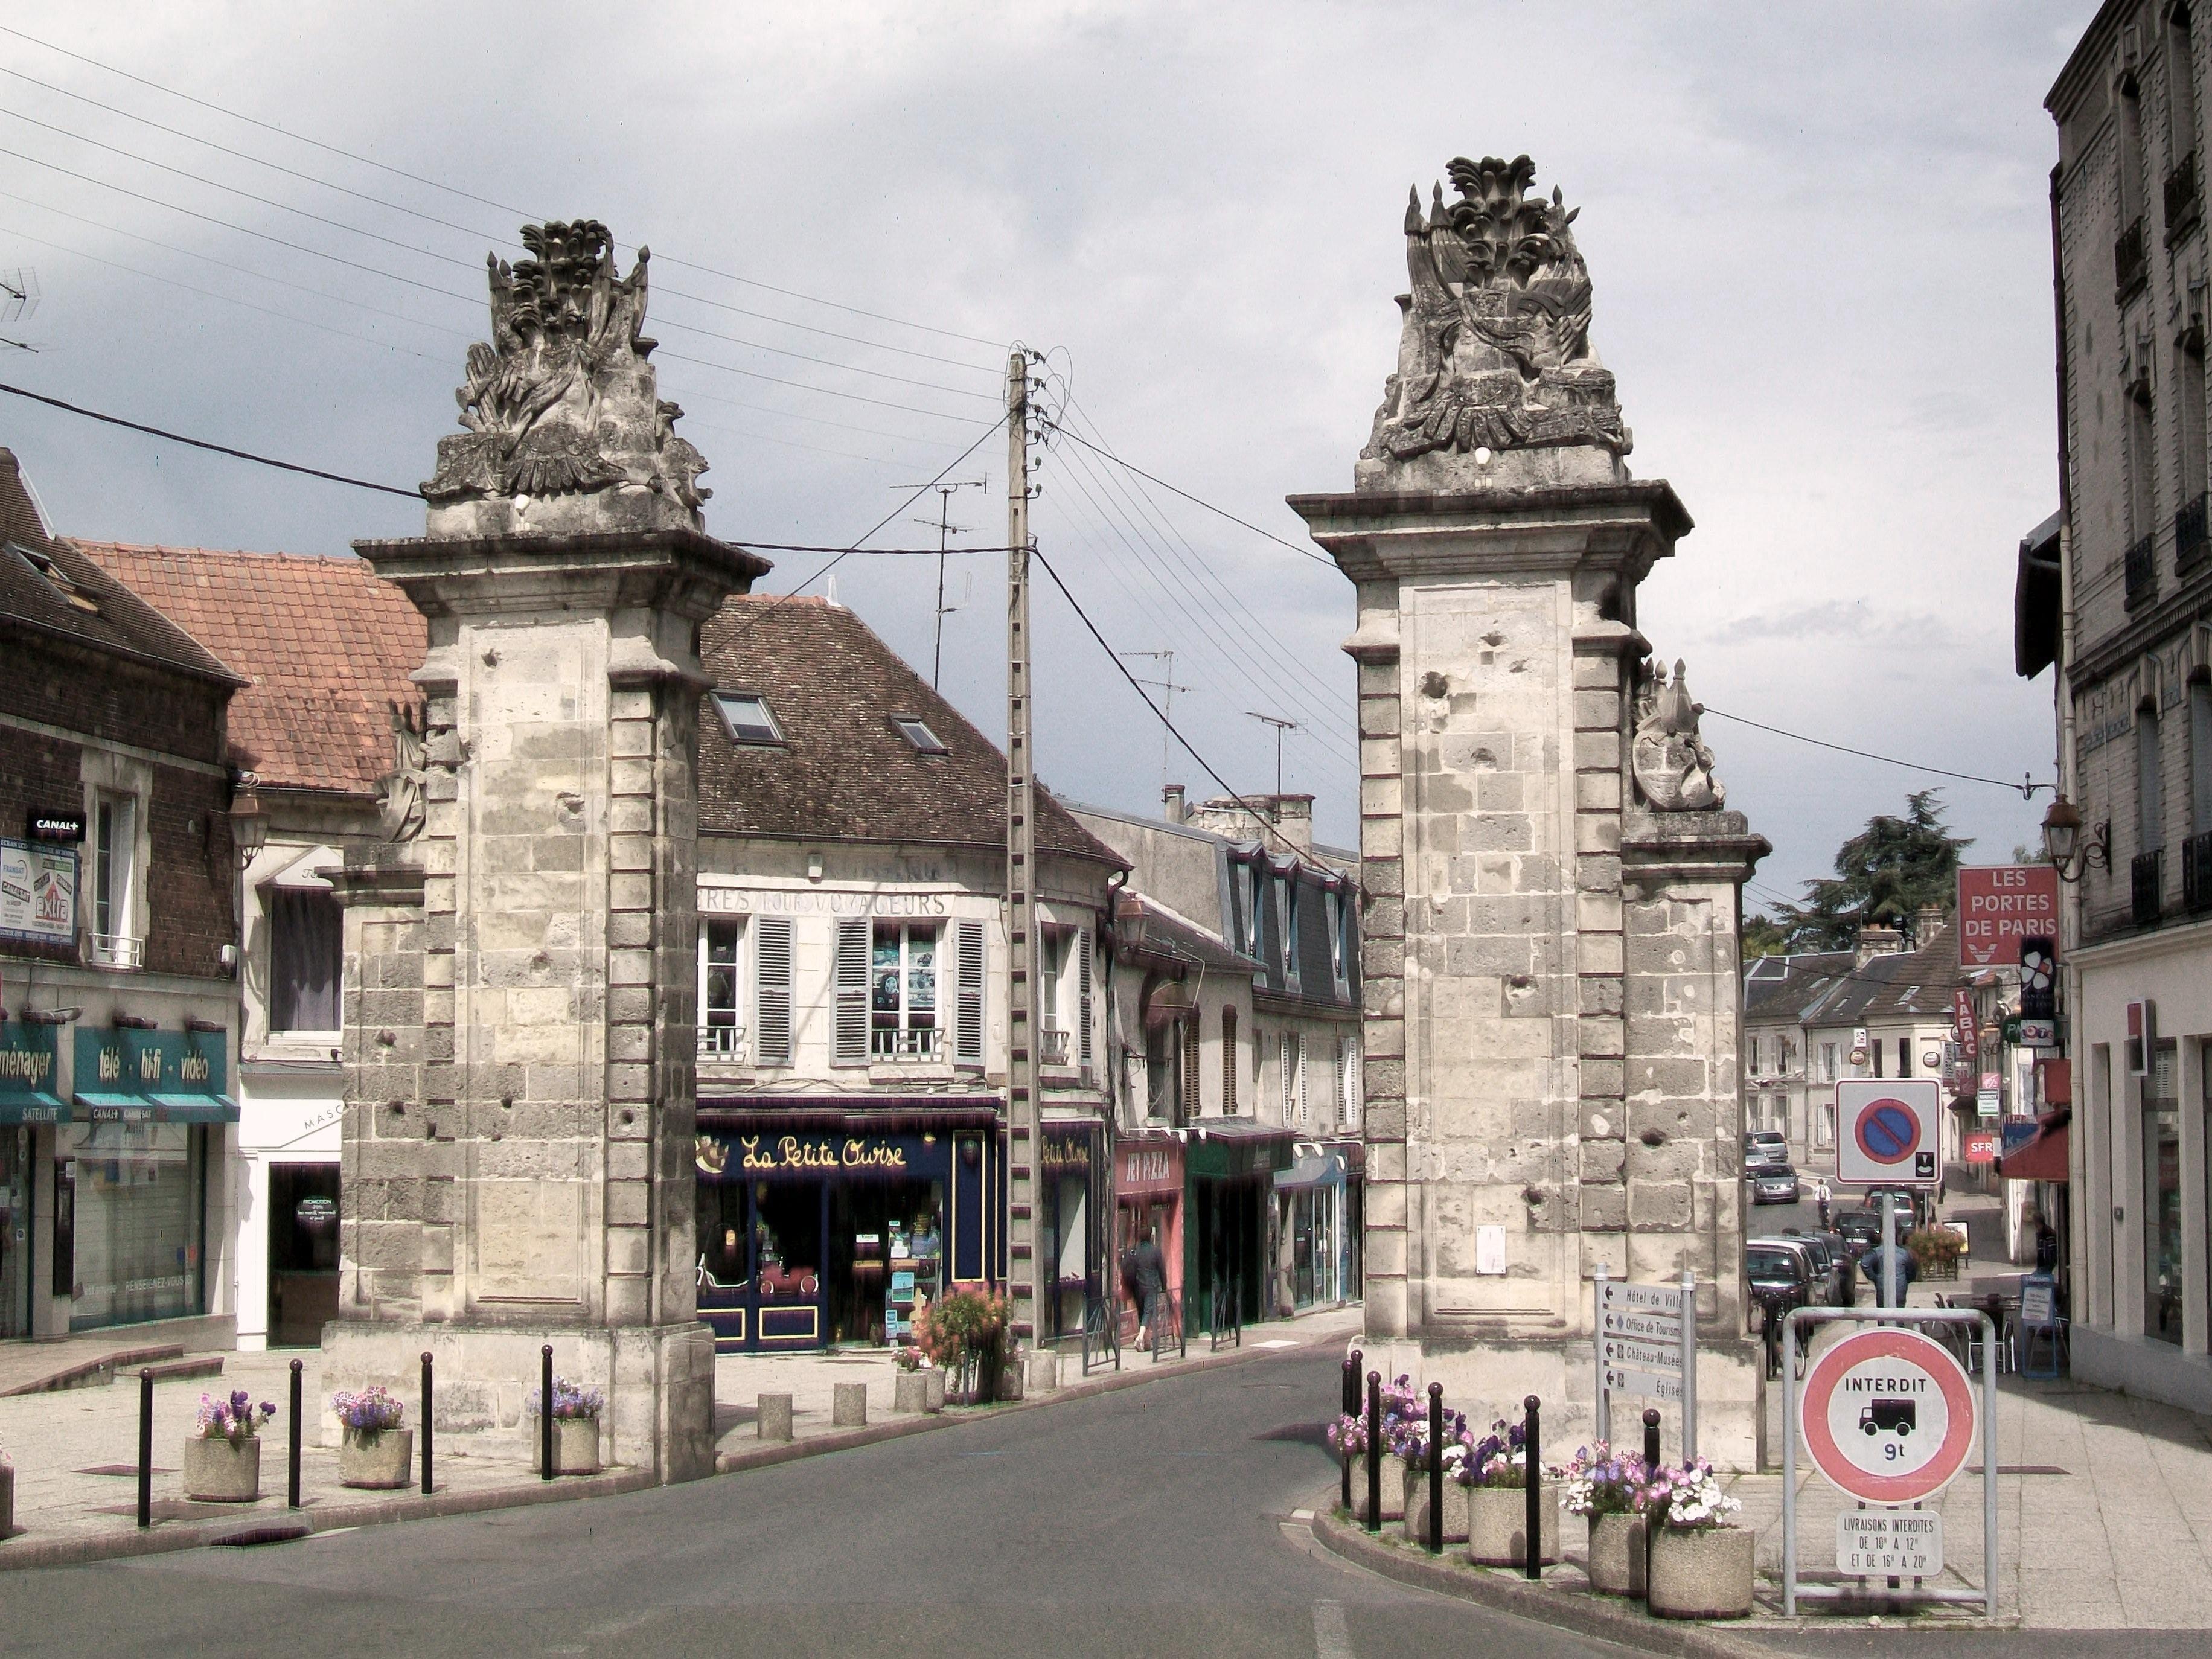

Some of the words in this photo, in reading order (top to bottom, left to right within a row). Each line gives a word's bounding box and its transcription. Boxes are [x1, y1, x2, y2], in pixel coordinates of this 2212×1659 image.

[36, 819, 78, 831] CANAL+
[1993, 870, 2027, 887] LES
[815, 893, 945, 915] VOYAGEURS
[1971, 894, 2050, 913] PORTES
[1965, 920, 1992, 936] DE
[1999, 919, 2056, 935] PARIS
[1956, 991, 1977, 1055] TABAC
[0, 1041, 51, 1085] ménager
[99, 1047, 120, 1079] télé
[181, 1050, 208, 1081] vidéo
[22, 1107, 57, 1120] SATELLITE
[741, 1136, 777, 1168] La
[777, 1136, 839, 1168] Petite
[842, 1139, 906, 1166] Ourse
[1971, 1142, 1993, 1152] SFR
[1127, 1152, 1140, 1182] JET
[1143, 1151, 1169, 1181] PIZZA
[1626, 1290, 1646, 1304] Hôtel
[1651, 1292, 1660, 1305] de
[1626, 1318, 1645, 1332] Office
[1646, 1321, 1654, 1334] de
[1846, 1378, 1927, 1392] INTERDIT
[1844, 1518, 1887, 1532] LIVRAISONS
[1892, 1519, 1934, 1533] INTERDITES
[1859, 1536, 1868, 1549] DE
[1894, 1538, 1899, 1550] A
[1851, 1553, 1860, 1567] ET
[1867, 1554, 1876, 1567] DE
[1901, 1555, 1907, 1568] A
